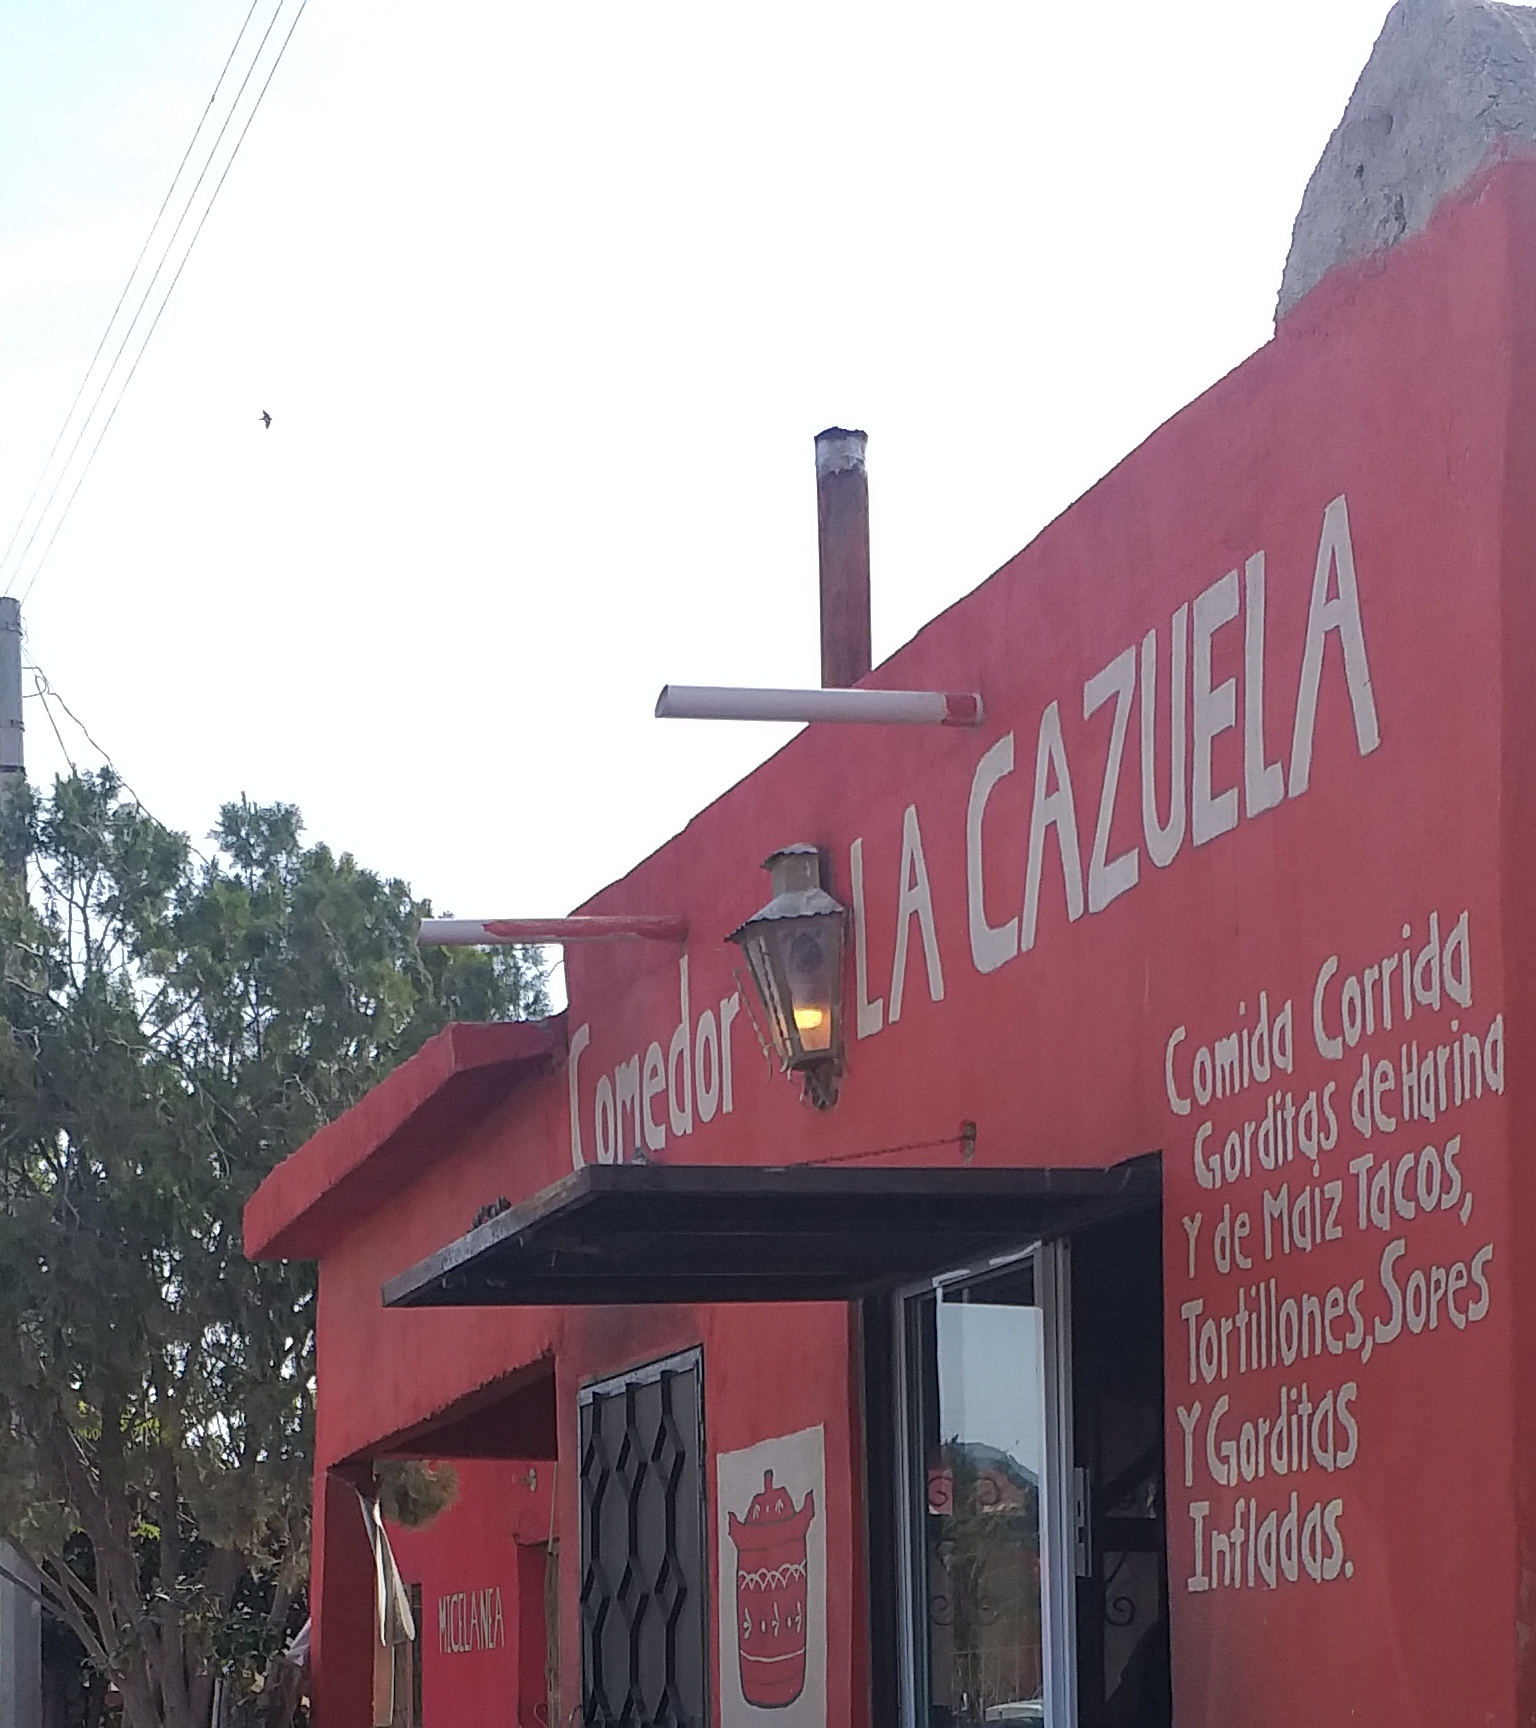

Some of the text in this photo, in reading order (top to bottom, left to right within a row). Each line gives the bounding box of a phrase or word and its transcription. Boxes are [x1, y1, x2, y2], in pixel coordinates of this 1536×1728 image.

[569, 493, 1381, 1171] Comedor LA CAZUELA
[1165, 910, 1472, 1116] Comida Corrida
[1194, 1013, 1505, 1190] Gorditas de Harina
[1181, 1212, 1202, 1278] Y
[1213, 1204, 1252, 1275] de
[1374, 1238, 1494, 1345] Sopes
[1177, 1381, 1358, 1488] Y Gorditas
[1187, 1491, 1354, 1593] Infladas.
[438, 1586, 505, 1654] MICELANEA
